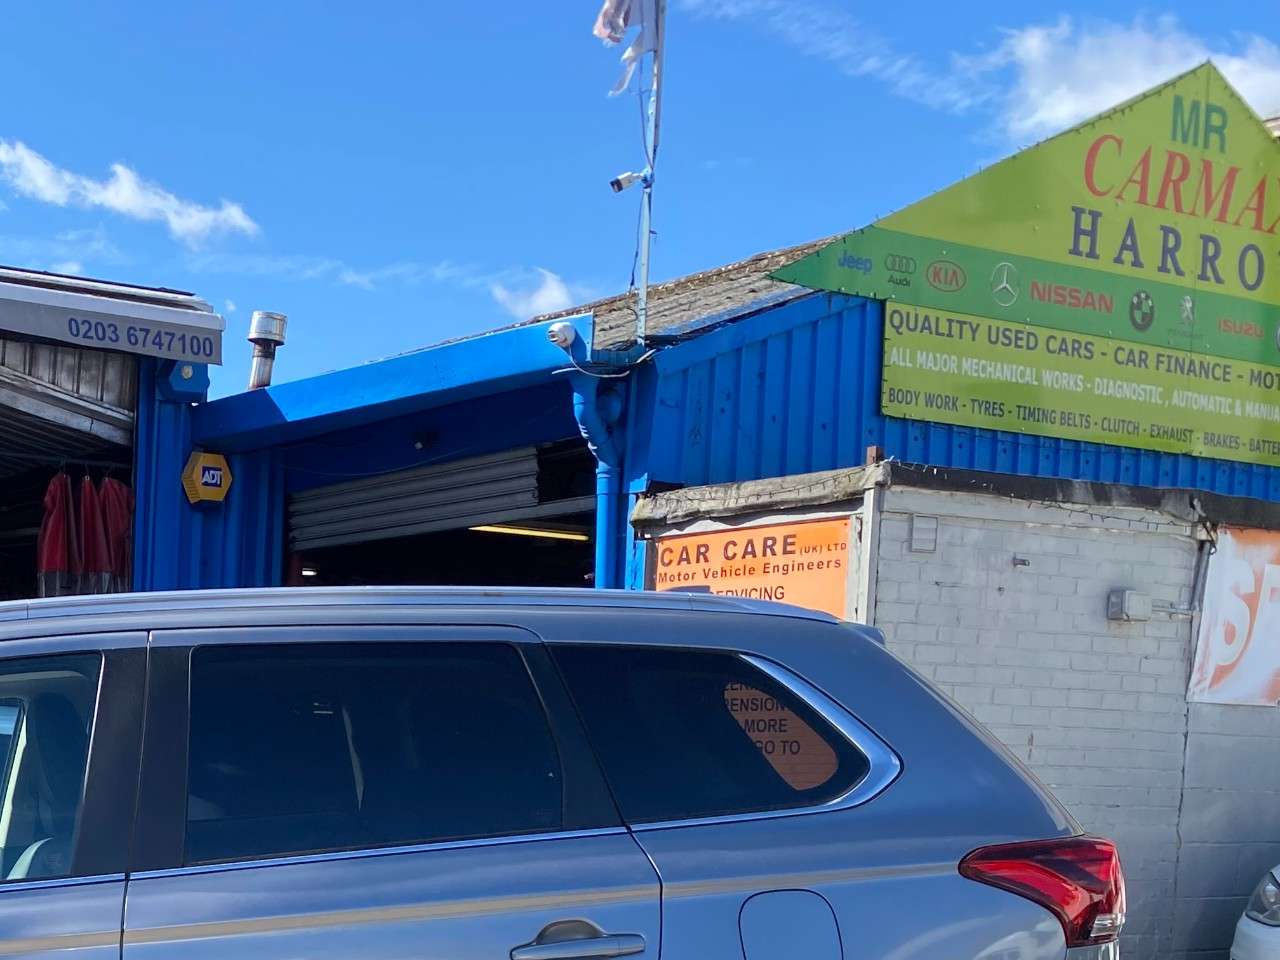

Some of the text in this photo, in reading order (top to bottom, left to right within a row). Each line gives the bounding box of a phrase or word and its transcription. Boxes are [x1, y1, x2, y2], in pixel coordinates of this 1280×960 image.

[1171, 95, 1228, 153] MR
[838, 251, 872, 274] Jeep
[1068, 206, 1280, 291] HARRO
[888, 275, 910, 287] Audi
[932, 266, 960, 286] KIA
[1030, 281, 1114, 313] NISSAN
[68, 318, 214, 357] 0203 6747100
[1218, 319, 1264, 338] ISUZU
[889, 309, 980, 342] QUALITY
[988, 324, 1038, 350] USED
[1046, 335, 1094, 360] CARS
[1114, 346, 1149, 369] CAR
[1155, 353, 1232, 382] FINANCE
[890, 347, 913, 367] ALL
[916, 350, 957, 373] MAJOR
[962, 357, 1039, 385] MECHANICAL
[1042, 370, 1083, 392] WORKS
[1172, 389, 1232, 415] AUTOMATIC
[888, 387, 920, 405] BODY
[924, 391, 959, 412] WORK
[970, 399, 1005, 418] TYRES
[1016, 404, 1056, 425] TIMING
[1060, 409, 1091, 429] BELTS
[1101, 417, 1140, 437] CLUTCH
[1150, 424, 1194, 443] EXHAUST
[1203, 431, 1240, 450] BRAKES
[201, 470, 222, 485] ADT
[660, 534, 847, 567] CAR CARE (UK) LTD
[658, 558, 841, 584] Motor Vehicle Engineers
[744, 718, 788, 733] MORE
[780, 740, 801, 755] TO
